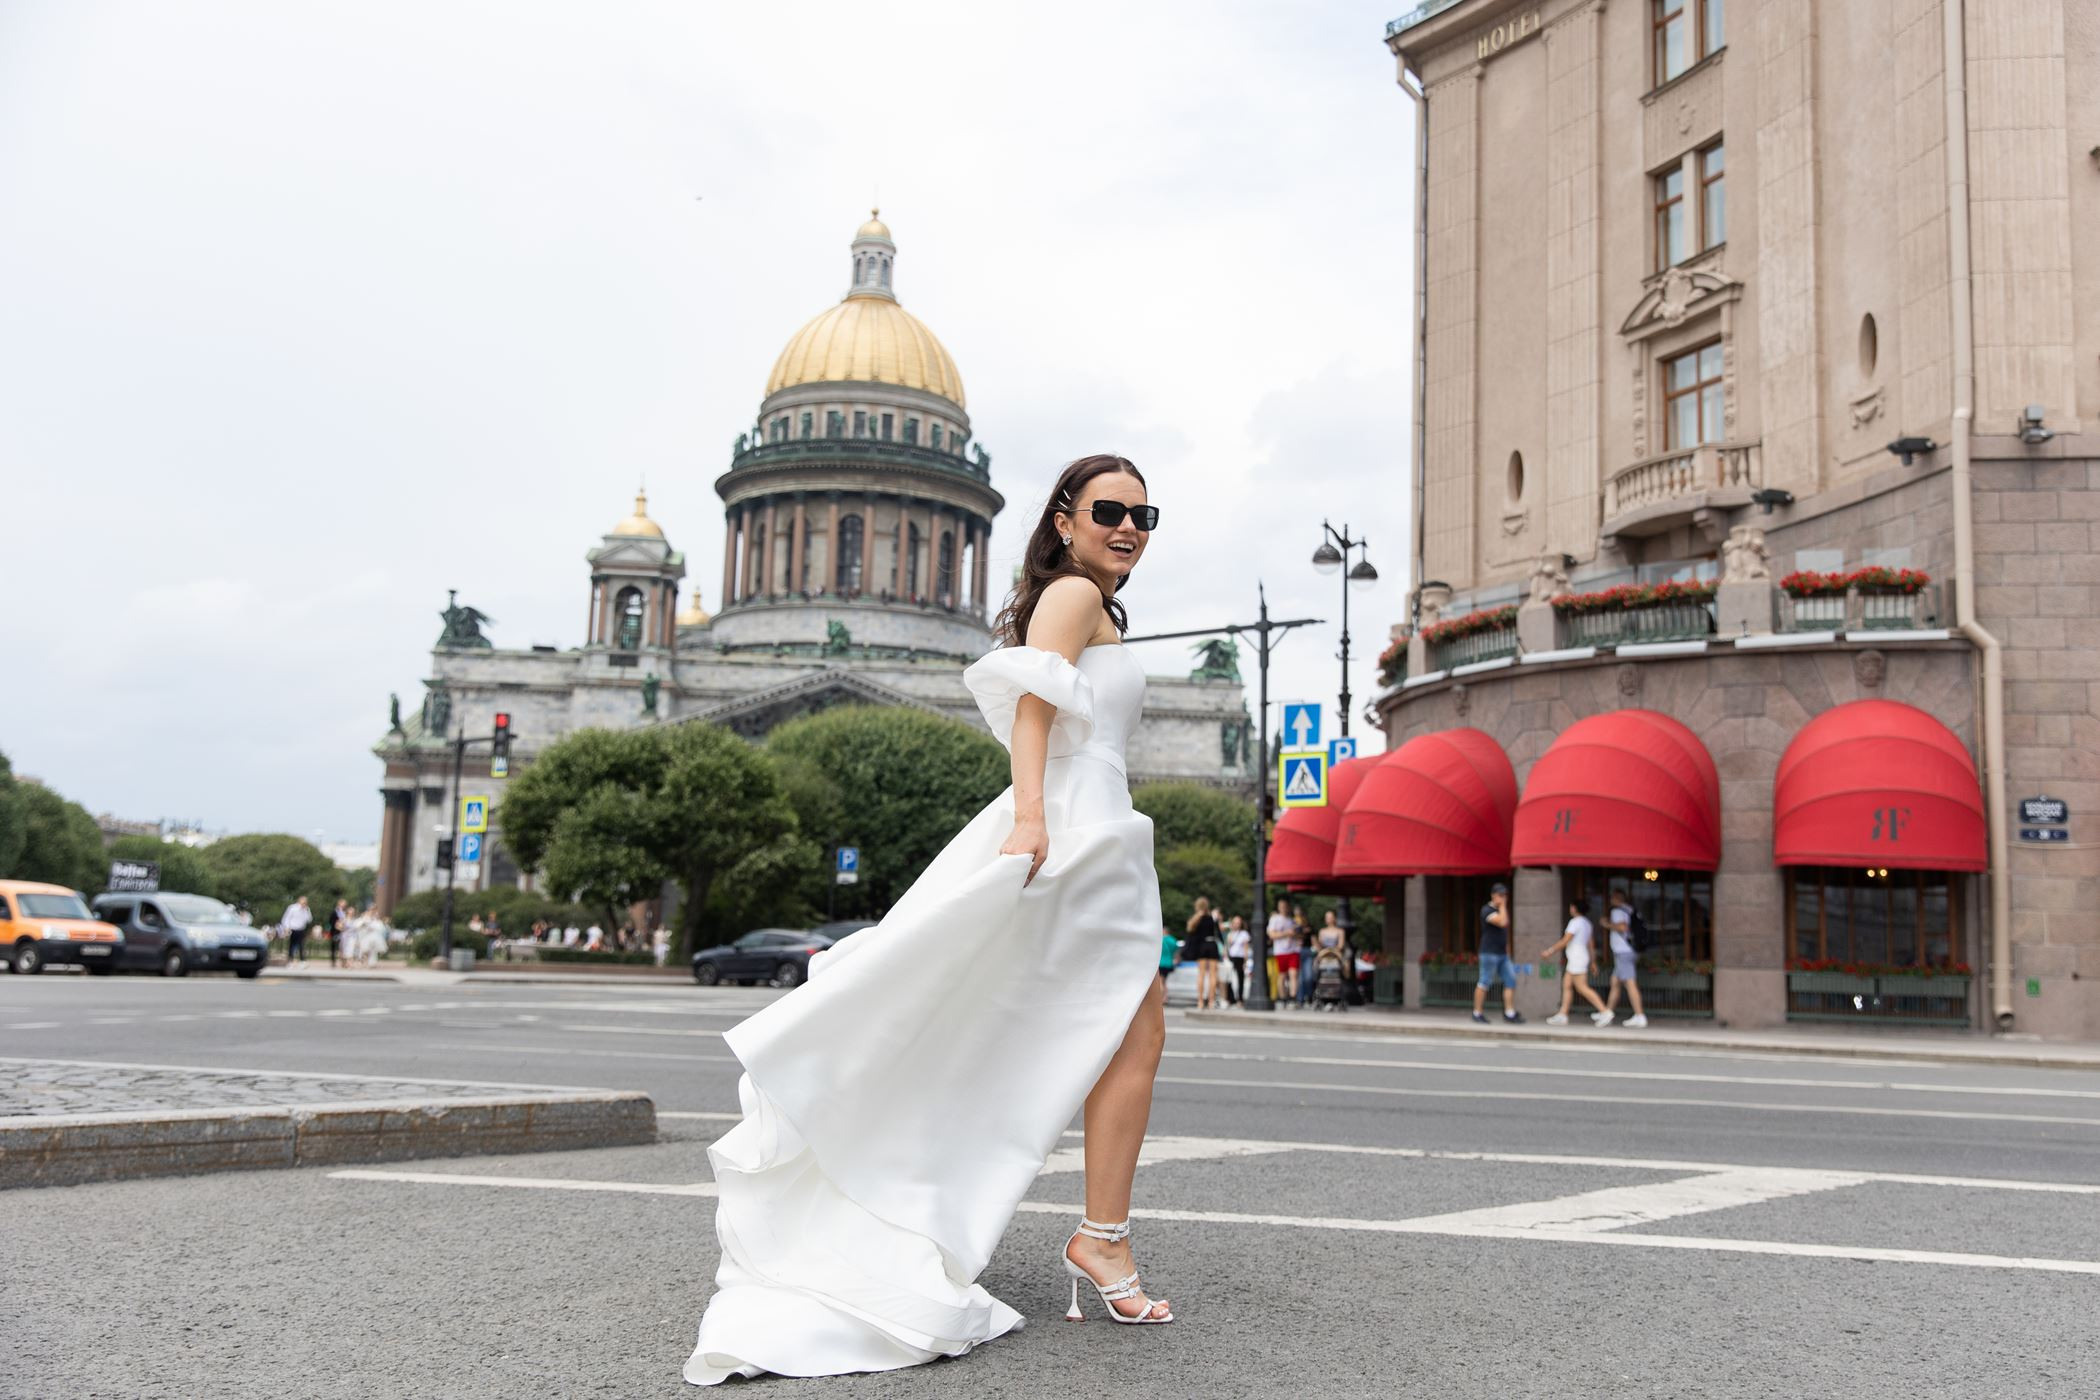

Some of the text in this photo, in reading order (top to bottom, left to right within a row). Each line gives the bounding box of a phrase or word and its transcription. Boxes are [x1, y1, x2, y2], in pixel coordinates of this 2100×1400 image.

[1335, 741, 1352, 763] P
[465, 836, 479, 860] P
[842, 849, 856, 870] P
